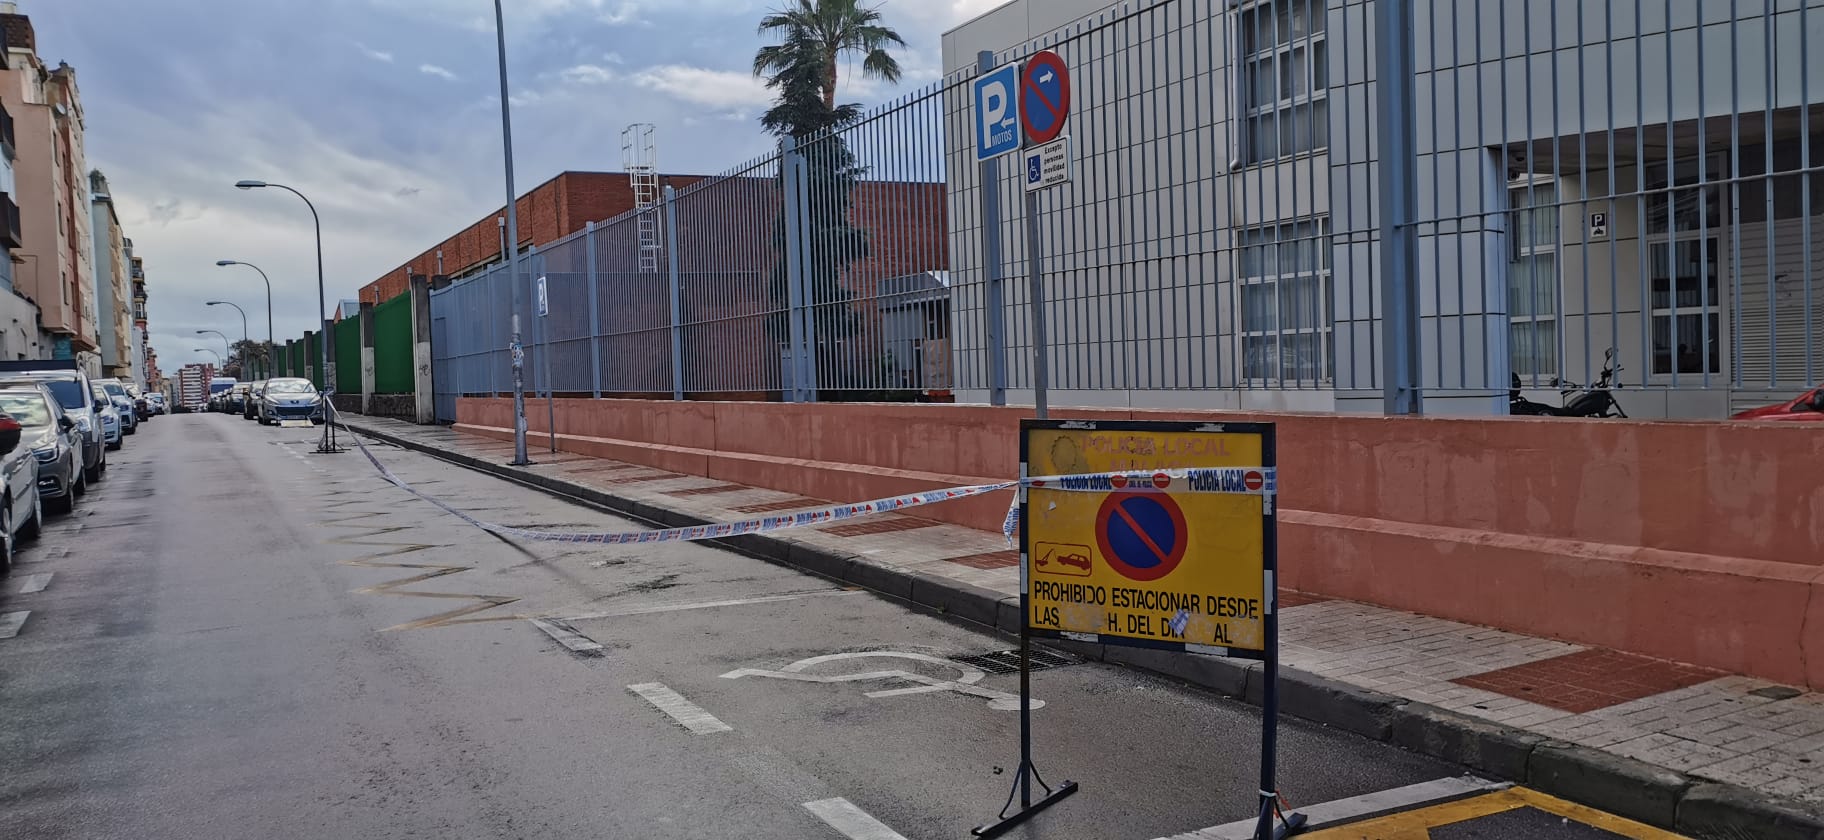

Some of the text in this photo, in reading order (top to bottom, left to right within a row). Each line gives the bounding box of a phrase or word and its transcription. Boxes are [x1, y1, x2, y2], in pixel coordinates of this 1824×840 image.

[982, 81, 1007, 149] P
[992, 130, 1012, 145] MOTOS
[1044, 144, 1062, 154] Excepto
[1044, 153, 1064, 165] personas
[1044, 162, 1065, 174] movilidad
[1045, 173, 1064, 183] reducida
[1594, 214, 1603, 226] P
[1082, 436, 1230, 457] POLICIA LOCAL
[1060, 476, 1089, 490] POLICIA
[1090, 474, 1112, 490] LOCAL
[1188, 470, 1220, 491] POLICIA
[1221, 470, 1246, 492] LOCAL
[1034, 581, 1259, 620] PROHIBIDO ESTACIONAR DESDE
[1034, 606, 1060, 627] LAS
[1108, 613, 1121, 633] H.
[1128, 614, 1155, 636] DEL
[1214, 623, 1233, 644] AL
